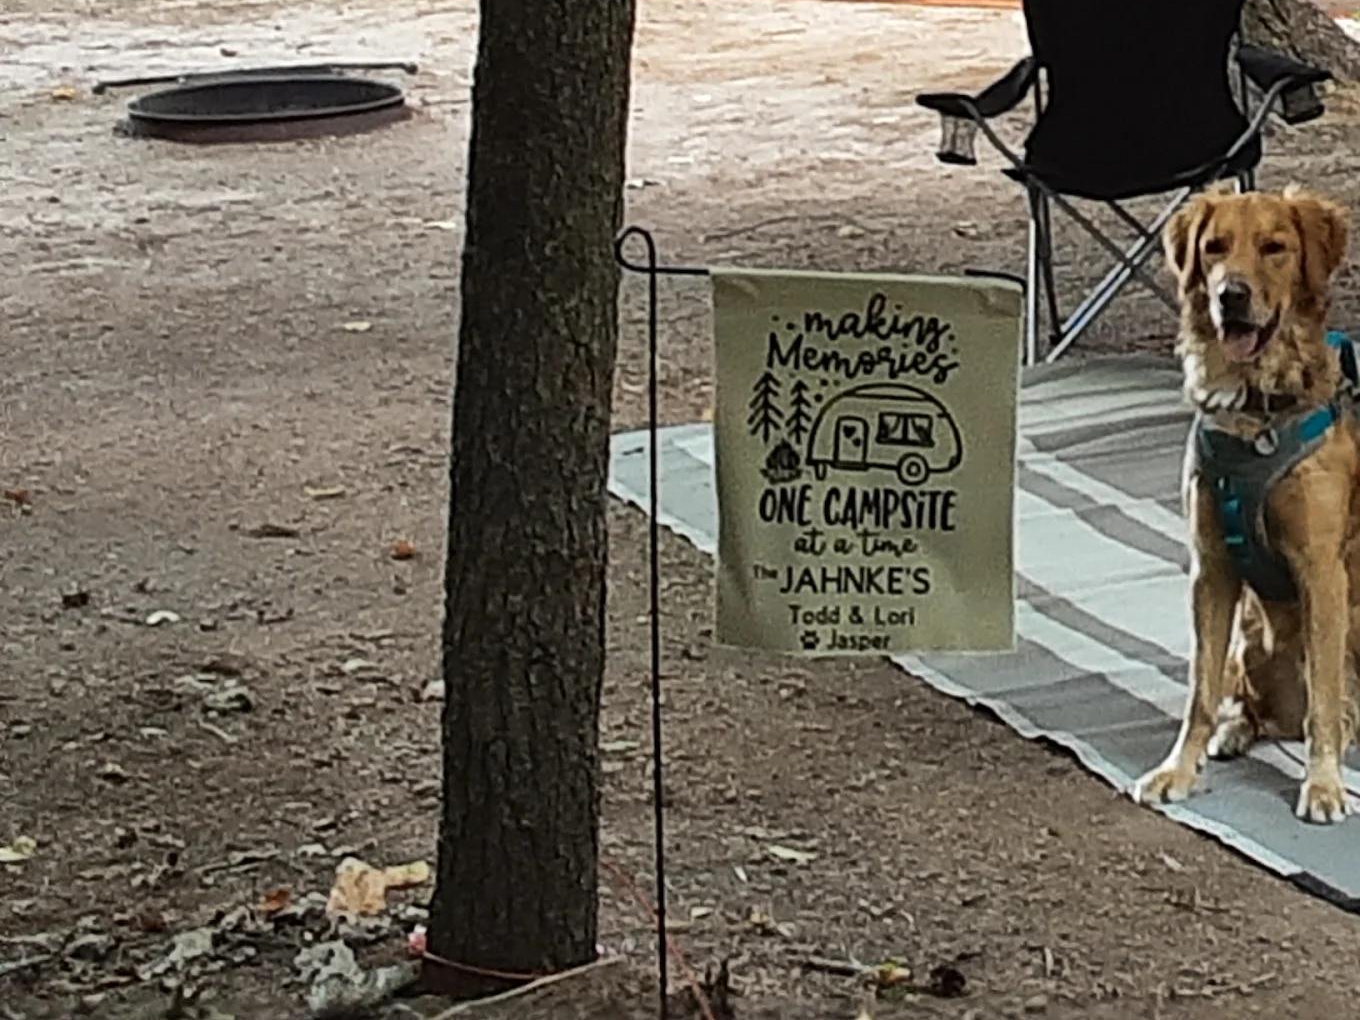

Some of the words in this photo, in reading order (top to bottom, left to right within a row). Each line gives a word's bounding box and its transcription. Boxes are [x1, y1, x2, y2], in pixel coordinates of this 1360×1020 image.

[803, 293, 950, 353] making
[766, 332, 959, 384] Memories
[759, 485, 812, 526] ONE
[794, 529, 827, 555] at
[833, 536, 857, 555] a
[857, 530, 918, 557] time
[753, 564, 778, 580] The
[779, 566, 931, 596] JAHNKE'S
[789, 605, 840, 626] Todd
[849, 605, 863, 626] &
[874, 606, 915, 627] Lori
[827, 628, 891, 652] Jasper
